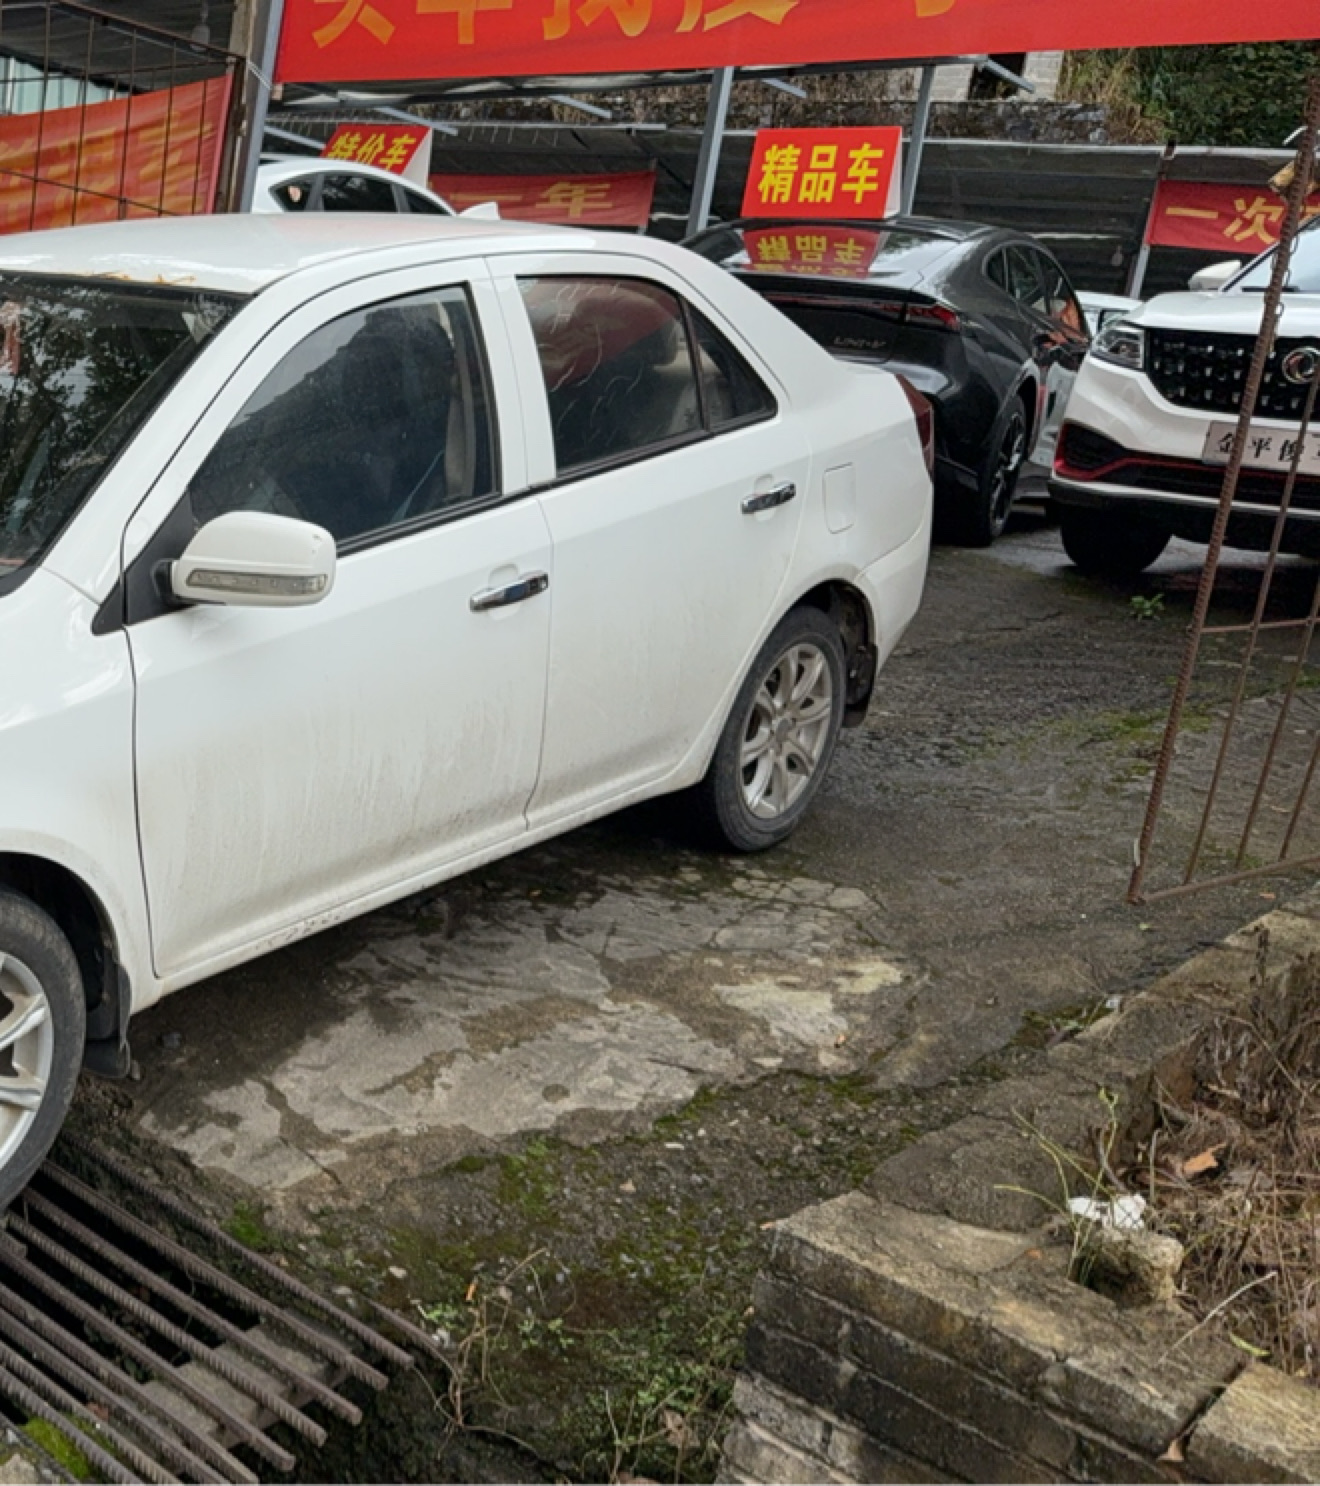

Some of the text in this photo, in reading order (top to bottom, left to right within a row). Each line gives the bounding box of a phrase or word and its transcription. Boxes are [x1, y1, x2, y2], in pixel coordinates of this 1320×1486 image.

[327, 132, 417, 172] 特价车
[758, 142, 884, 204] 精品车
[432, 181, 613, 217] 一年
[1165, 196, 1320, 244] 一次
